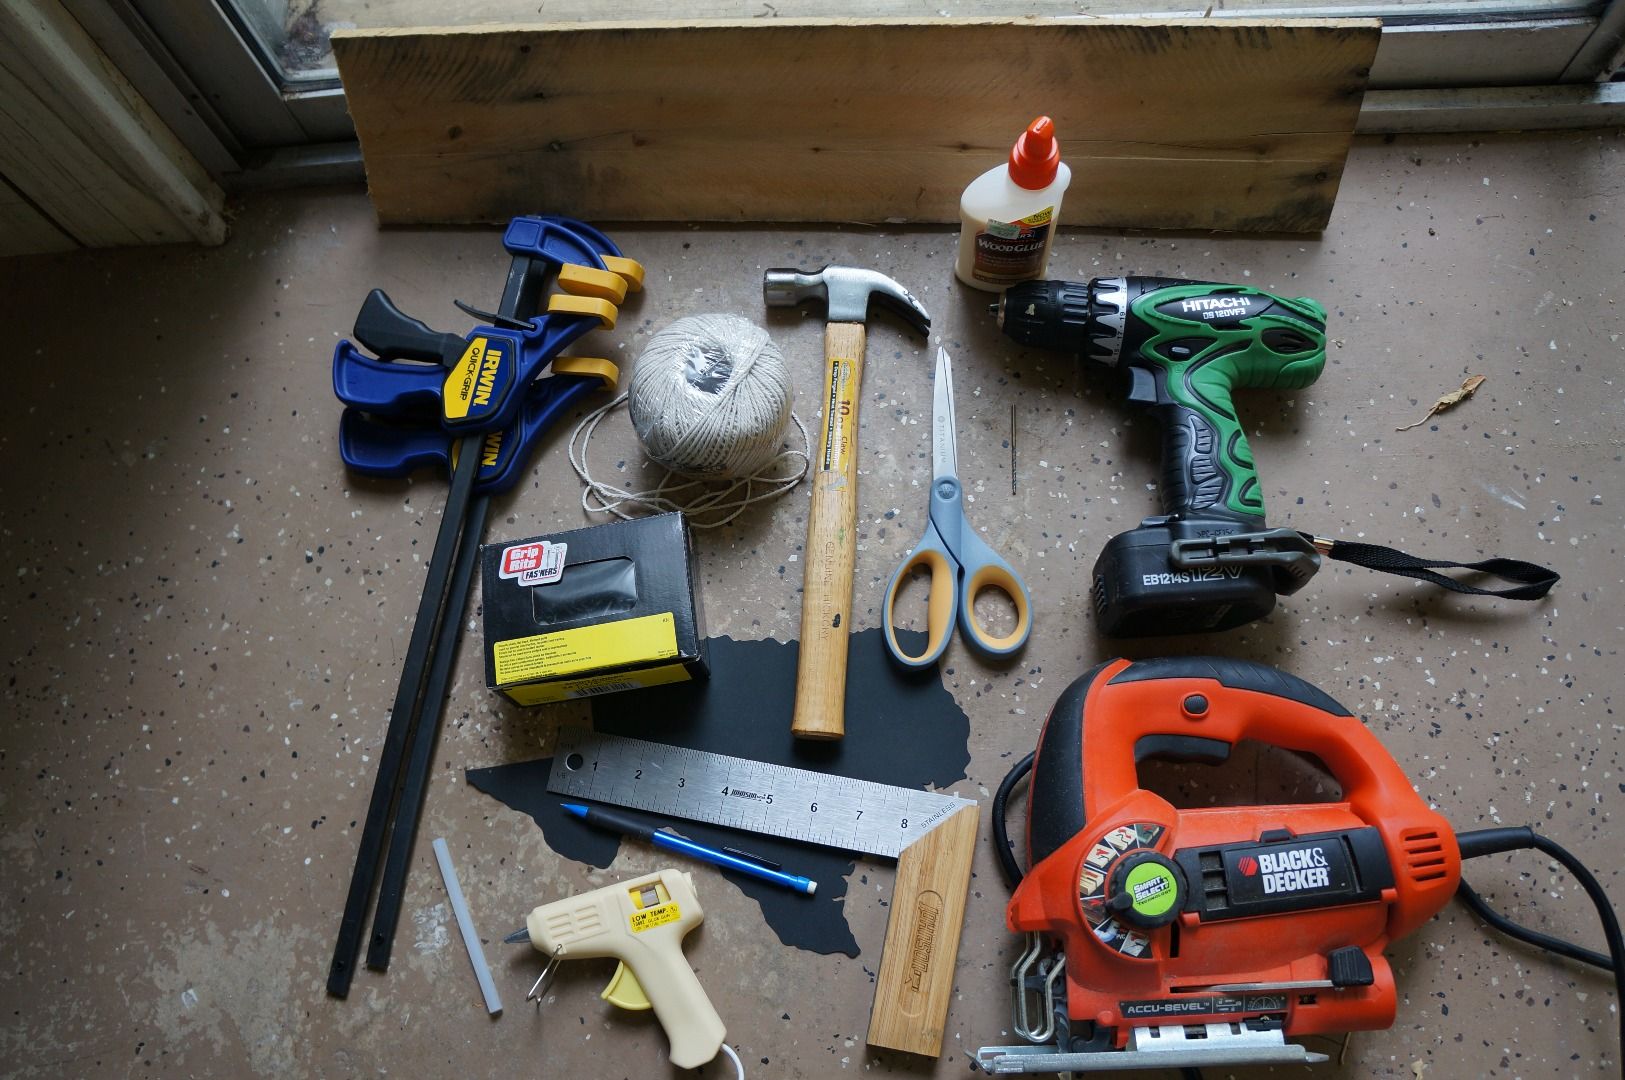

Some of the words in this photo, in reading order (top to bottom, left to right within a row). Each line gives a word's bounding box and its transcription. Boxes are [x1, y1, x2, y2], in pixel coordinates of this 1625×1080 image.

[1182, 297, 1251, 312] HITACHI
[460, 347, 480, 401] QUICK-GRIP
[474, 349, 502, 405] IRWIN
[838, 399, 851, 416] 10
[481, 431, 502, 466] WIN
[840, 436, 848, 455] Claw
[525, 567, 558, 579] FAS'NERS
[1143, 572, 1190, 586] EB1214S
[592, 760, 598, 771] 1
[635, 769, 643, 779] 2
[678, 777, 686, 788] 3
[721, 786, 729, 796] 4
[765, 794, 773, 804] 5
[810, 802, 818, 813] 6
[856, 810, 863, 820] 7
[920, 802, 956, 829] STAINLESS
[901, 818, 908, 829] 8
[1262, 867, 1330, 894] DECKER
[631, 914, 647, 922] LOW
[1127, 1002, 1205, 1014] ACCU-BEVEL
